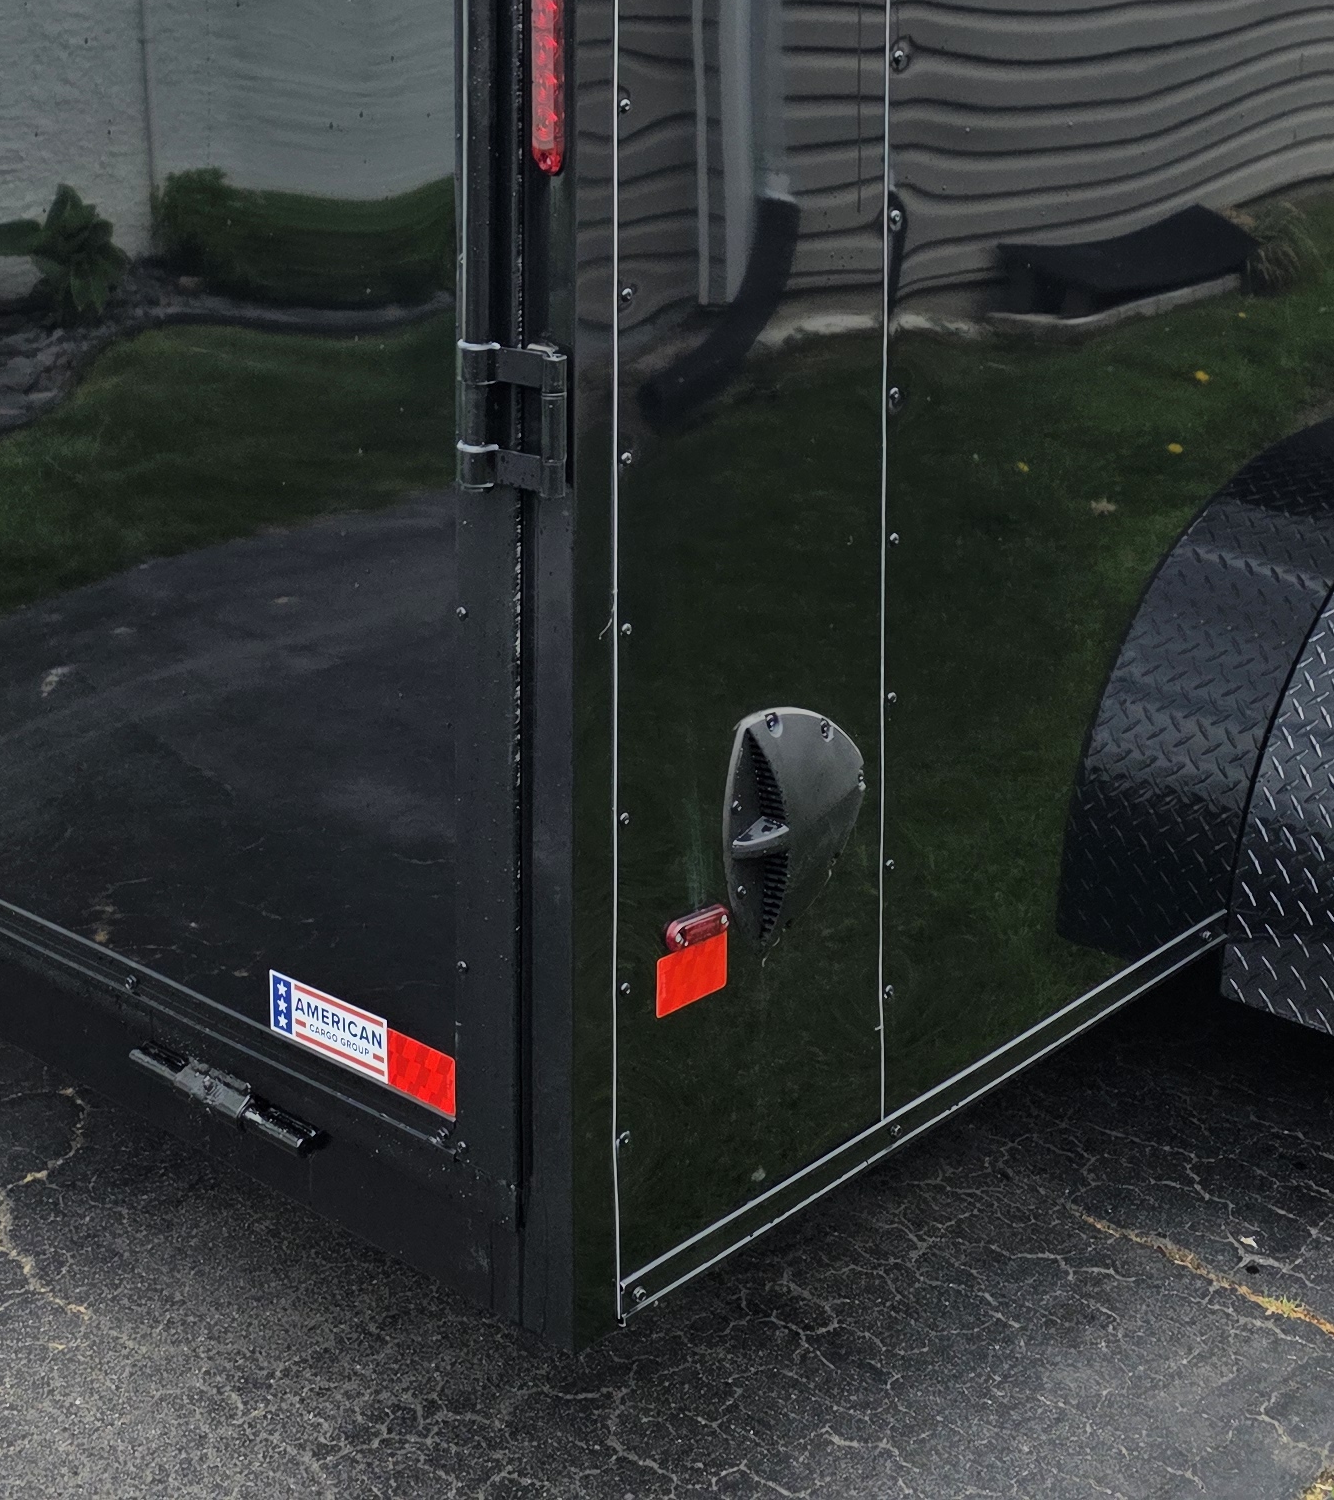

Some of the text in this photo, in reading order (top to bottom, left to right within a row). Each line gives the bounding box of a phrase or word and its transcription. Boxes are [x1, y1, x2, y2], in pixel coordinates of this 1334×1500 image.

[295, 998, 382, 1049] AMERICAN
[309, 1023, 370, 1056] CARGO GROUP
